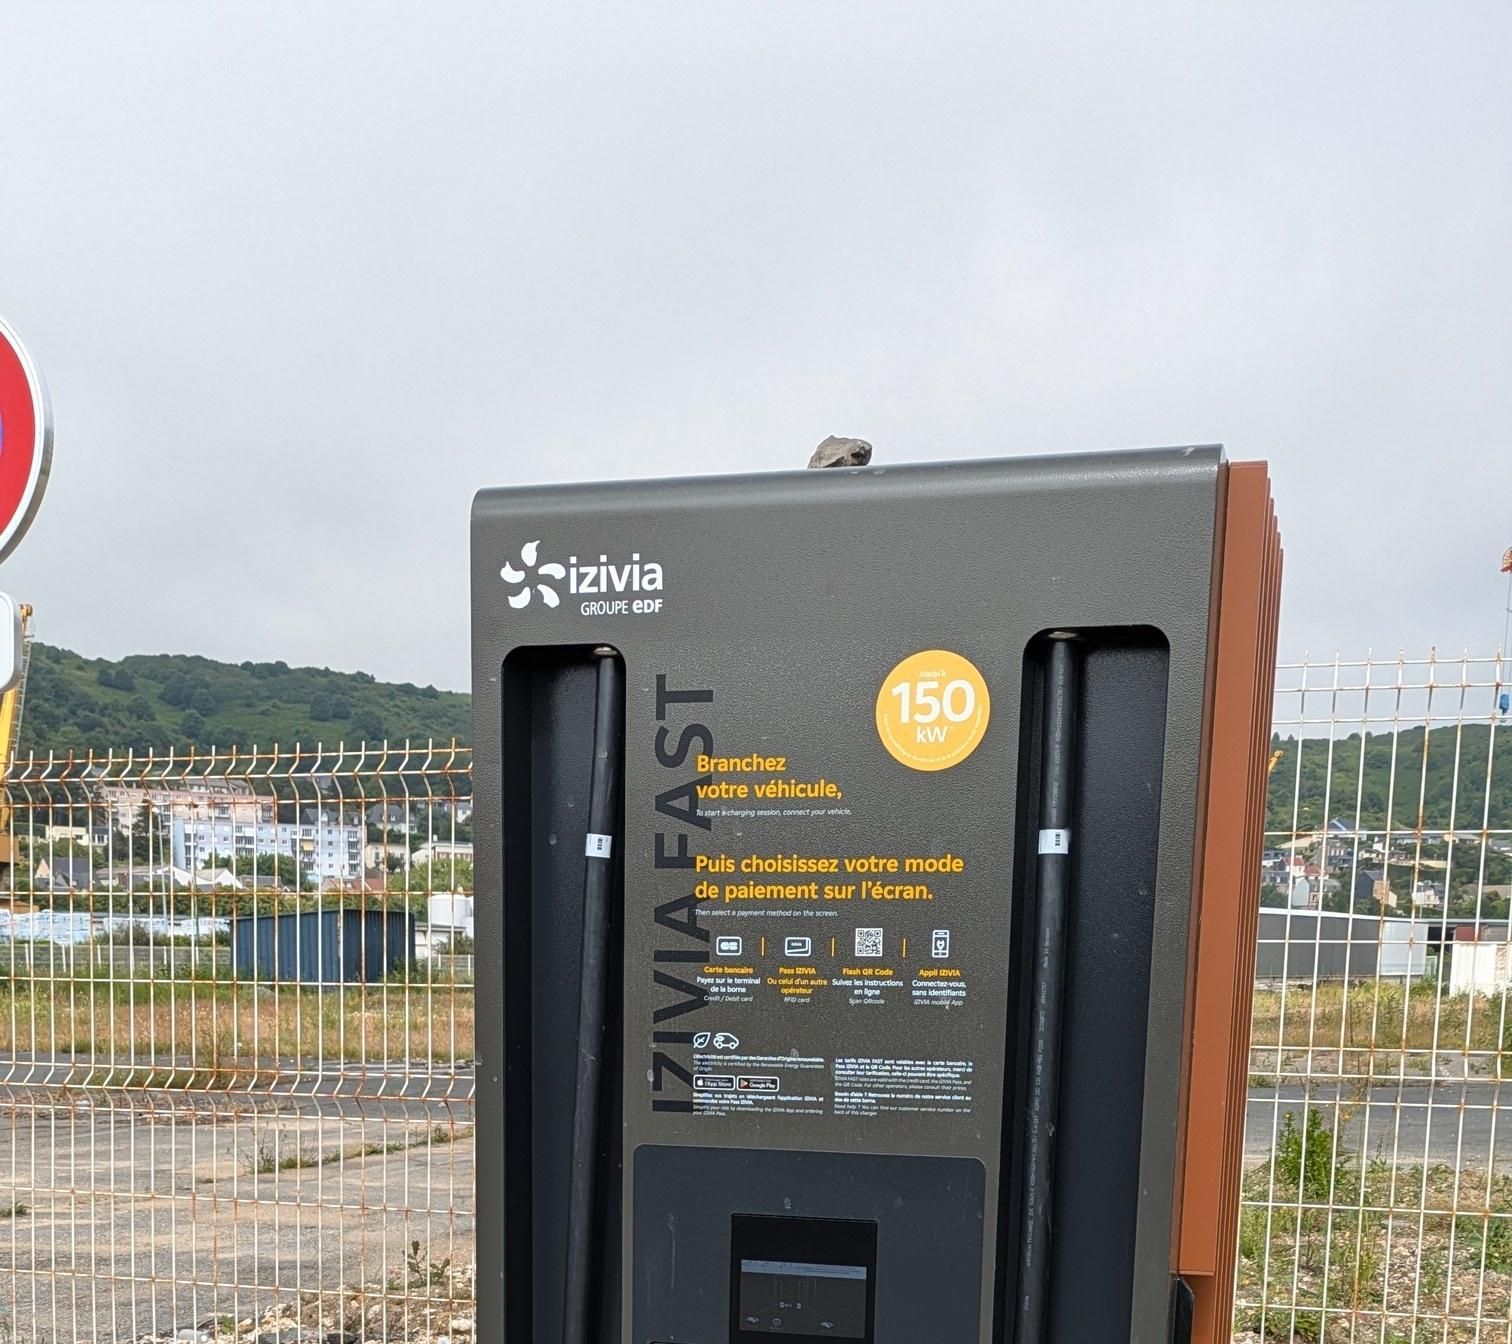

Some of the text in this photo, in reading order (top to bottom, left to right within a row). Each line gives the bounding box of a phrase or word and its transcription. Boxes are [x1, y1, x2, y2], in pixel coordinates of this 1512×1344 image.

[570, 553, 663, 594] izivia
[580, 599, 663, 616] GROUPE eDF
[891, 680, 975, 724] 150
[697, 754, 786, 772] Branchez
[696, 780, 842, 799] votre véhicule,
[696, 854, 964, 872] Puis choisissez votre mode
[652, 674, 714, 1113] IZIVIA FAST
[695, 880, 933, 902] de paiement sur l'écran.
[737, 909, 764, 917] payment
[696, 976, 714, 984] Payez
[735, 976, 760, 985] terminal
[919, 969, 937, 977] Appli
